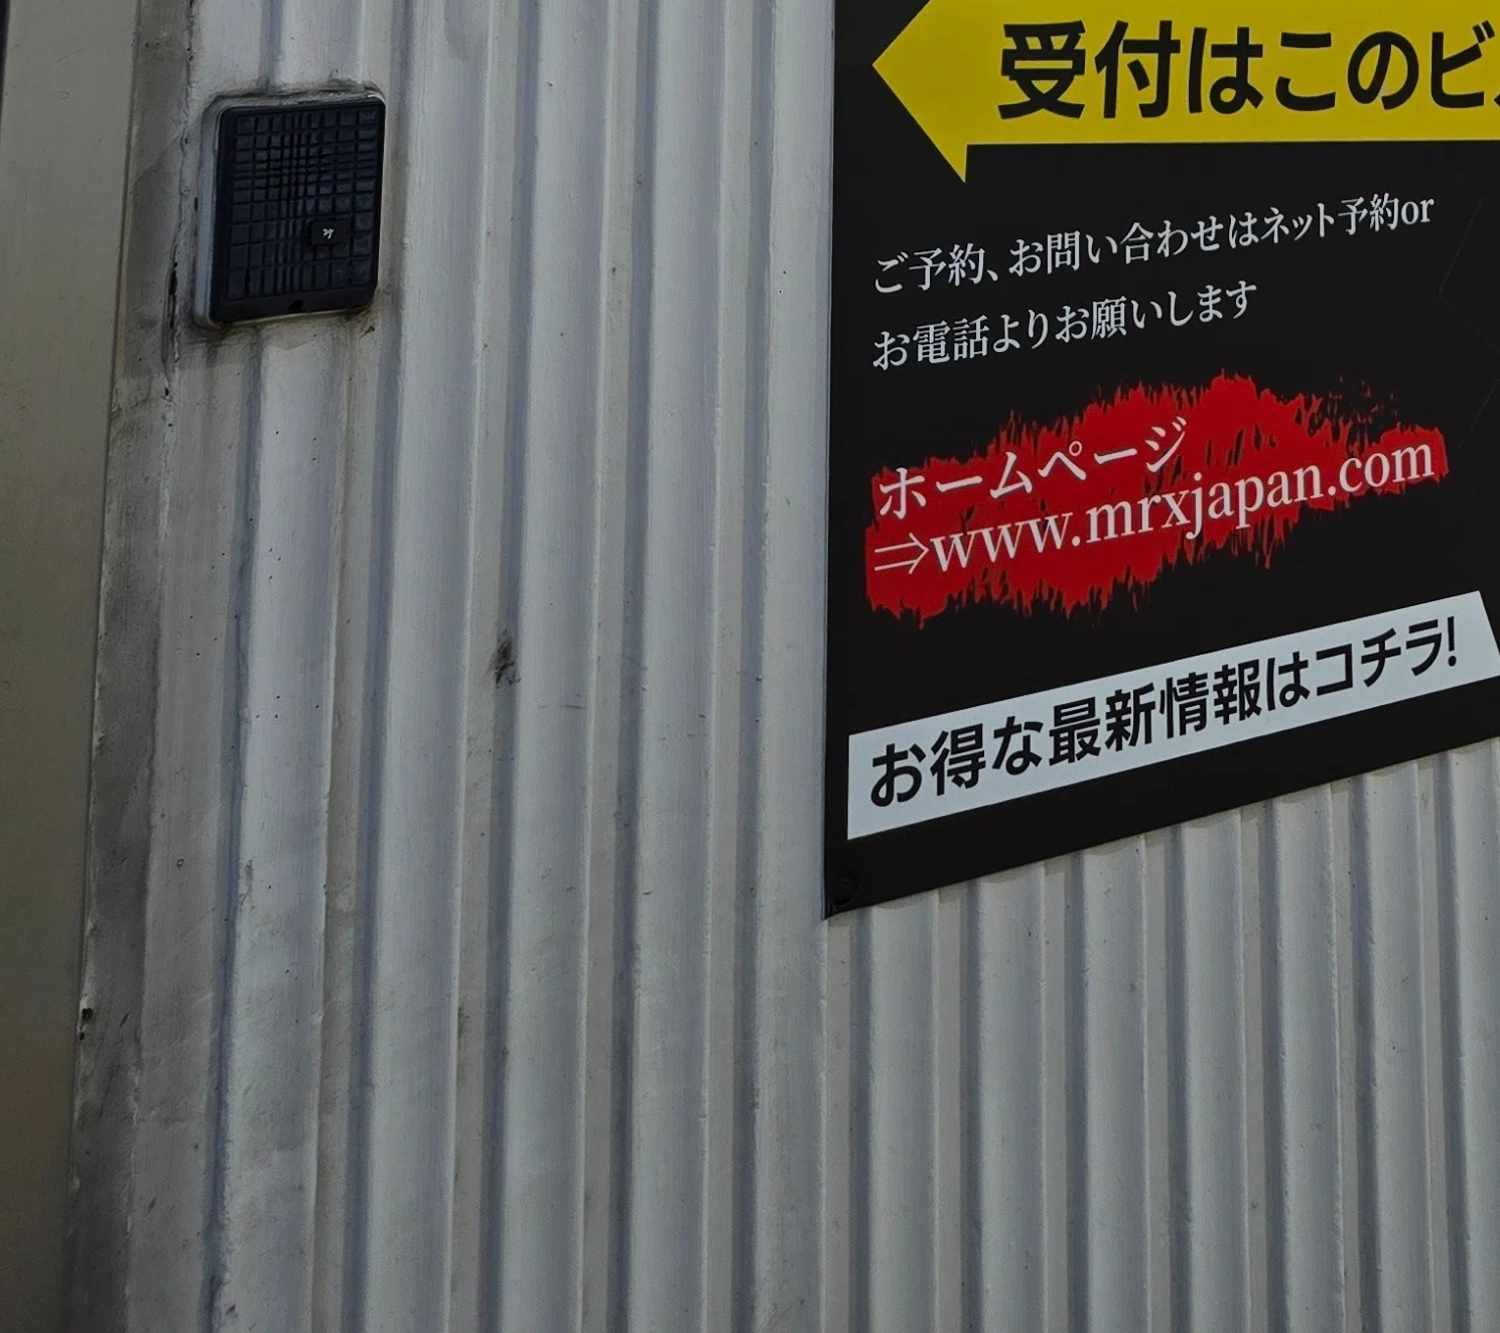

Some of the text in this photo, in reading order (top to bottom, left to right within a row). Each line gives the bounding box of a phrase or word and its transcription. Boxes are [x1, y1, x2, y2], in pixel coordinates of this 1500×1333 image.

[872, 280, 1257, 370] お電話よりお願いします
[879, 416, 1187, 521] ホームページ
[869, 613, 1457, 809] お得な最新情報はコチラ!
